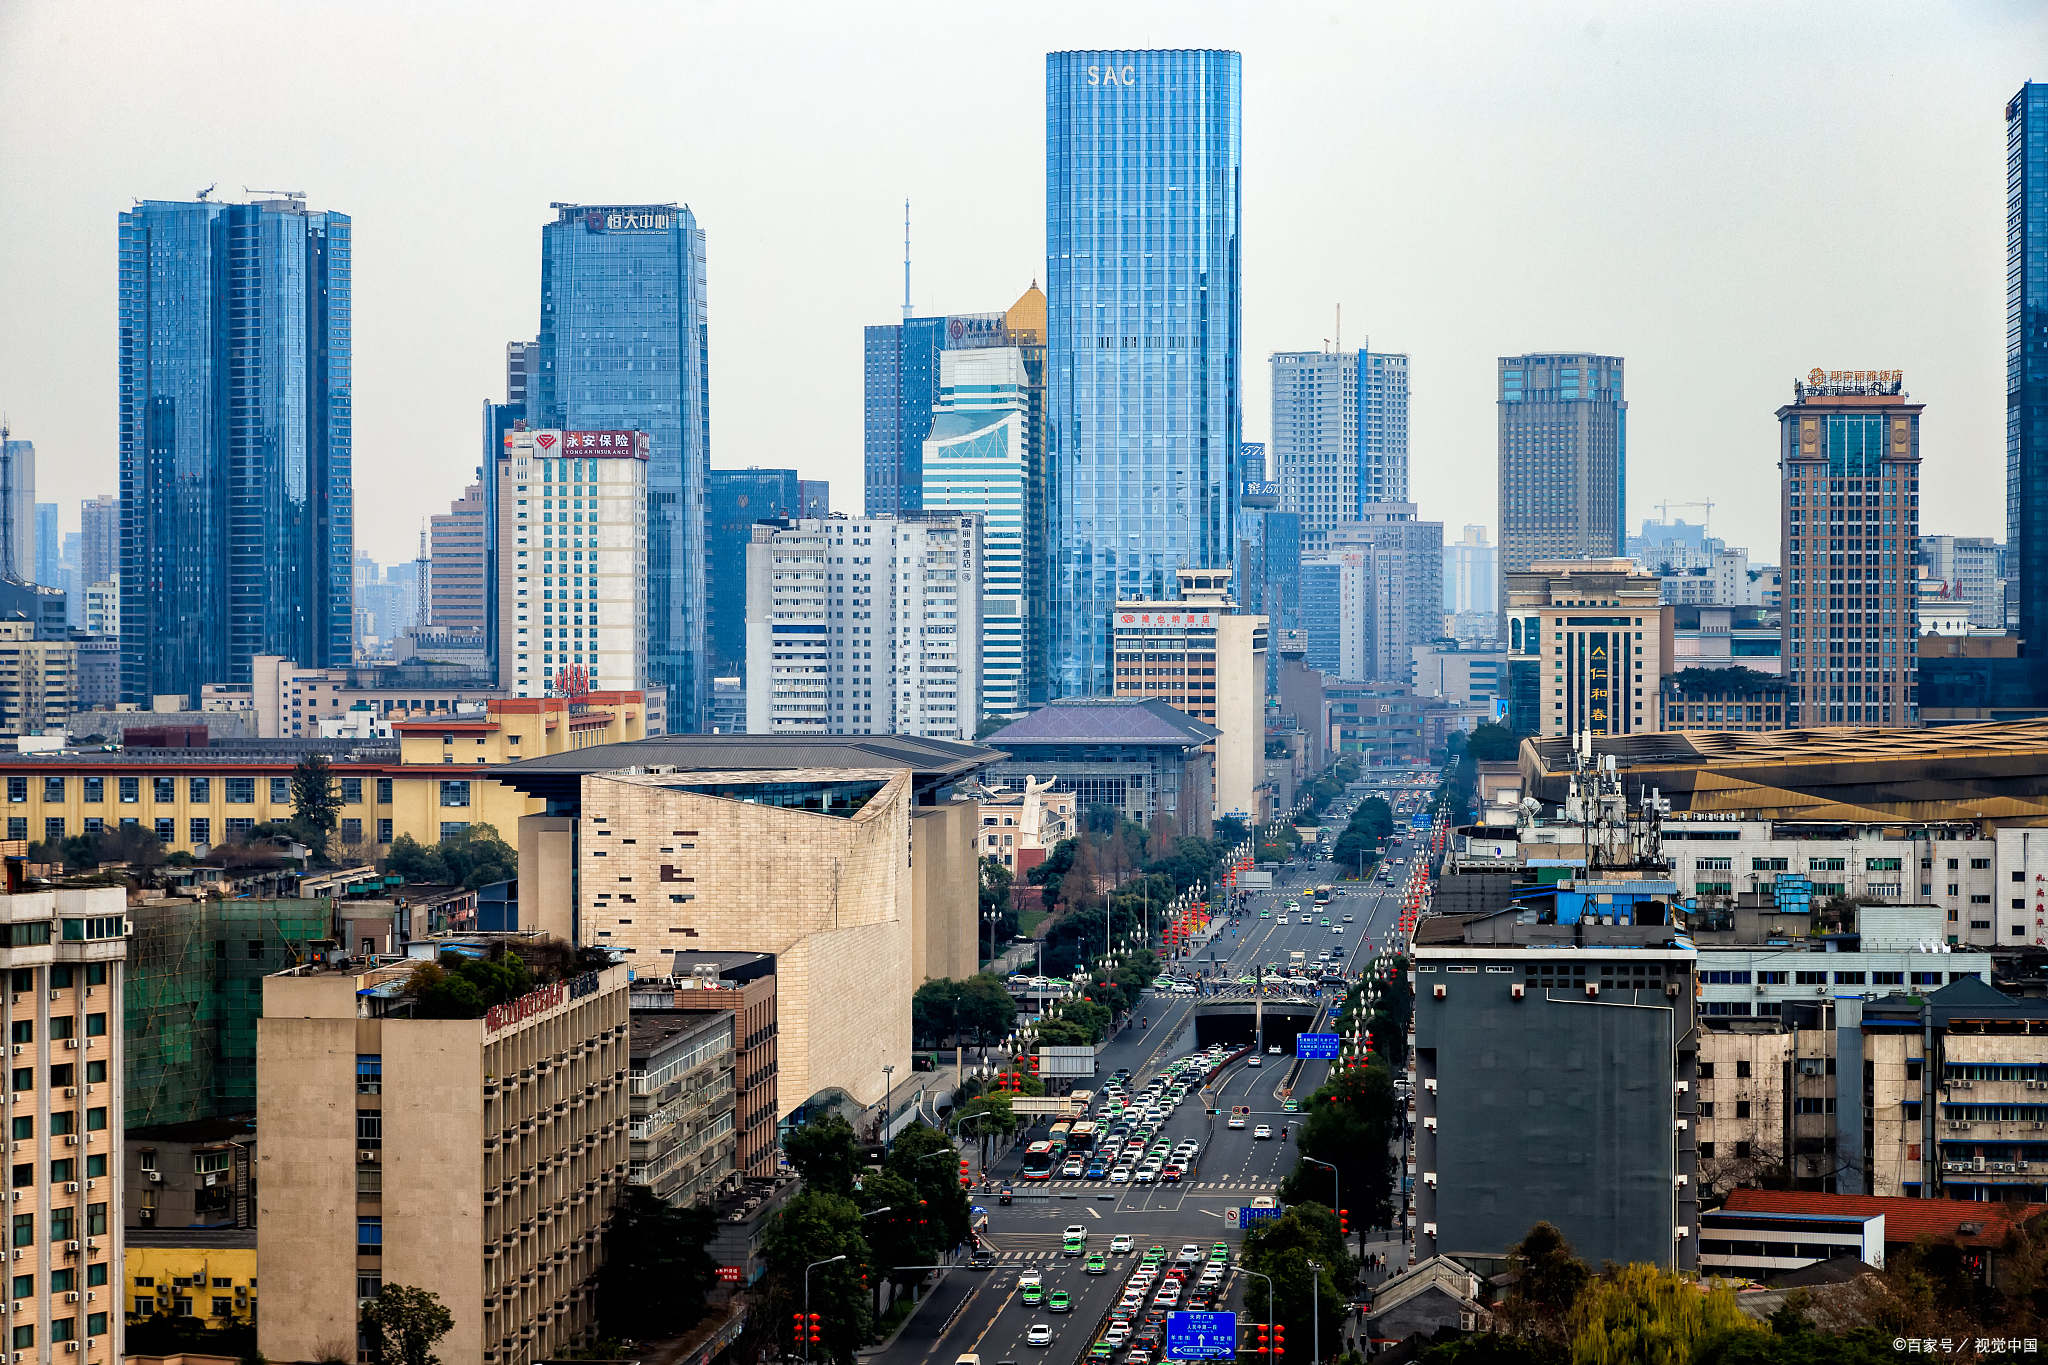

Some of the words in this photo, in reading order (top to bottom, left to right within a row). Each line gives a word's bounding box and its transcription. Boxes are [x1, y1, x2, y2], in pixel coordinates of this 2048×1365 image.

[1087, 65, 1135, 86] SAC
[607, 214, 669, 229] 恒大中心
[1831, 369, 1904, 382] 明宇丽雅饭店
[566, 434, 630, 448] 永安保险
[1141, 614, 1210, 624] 维也纳酒店
